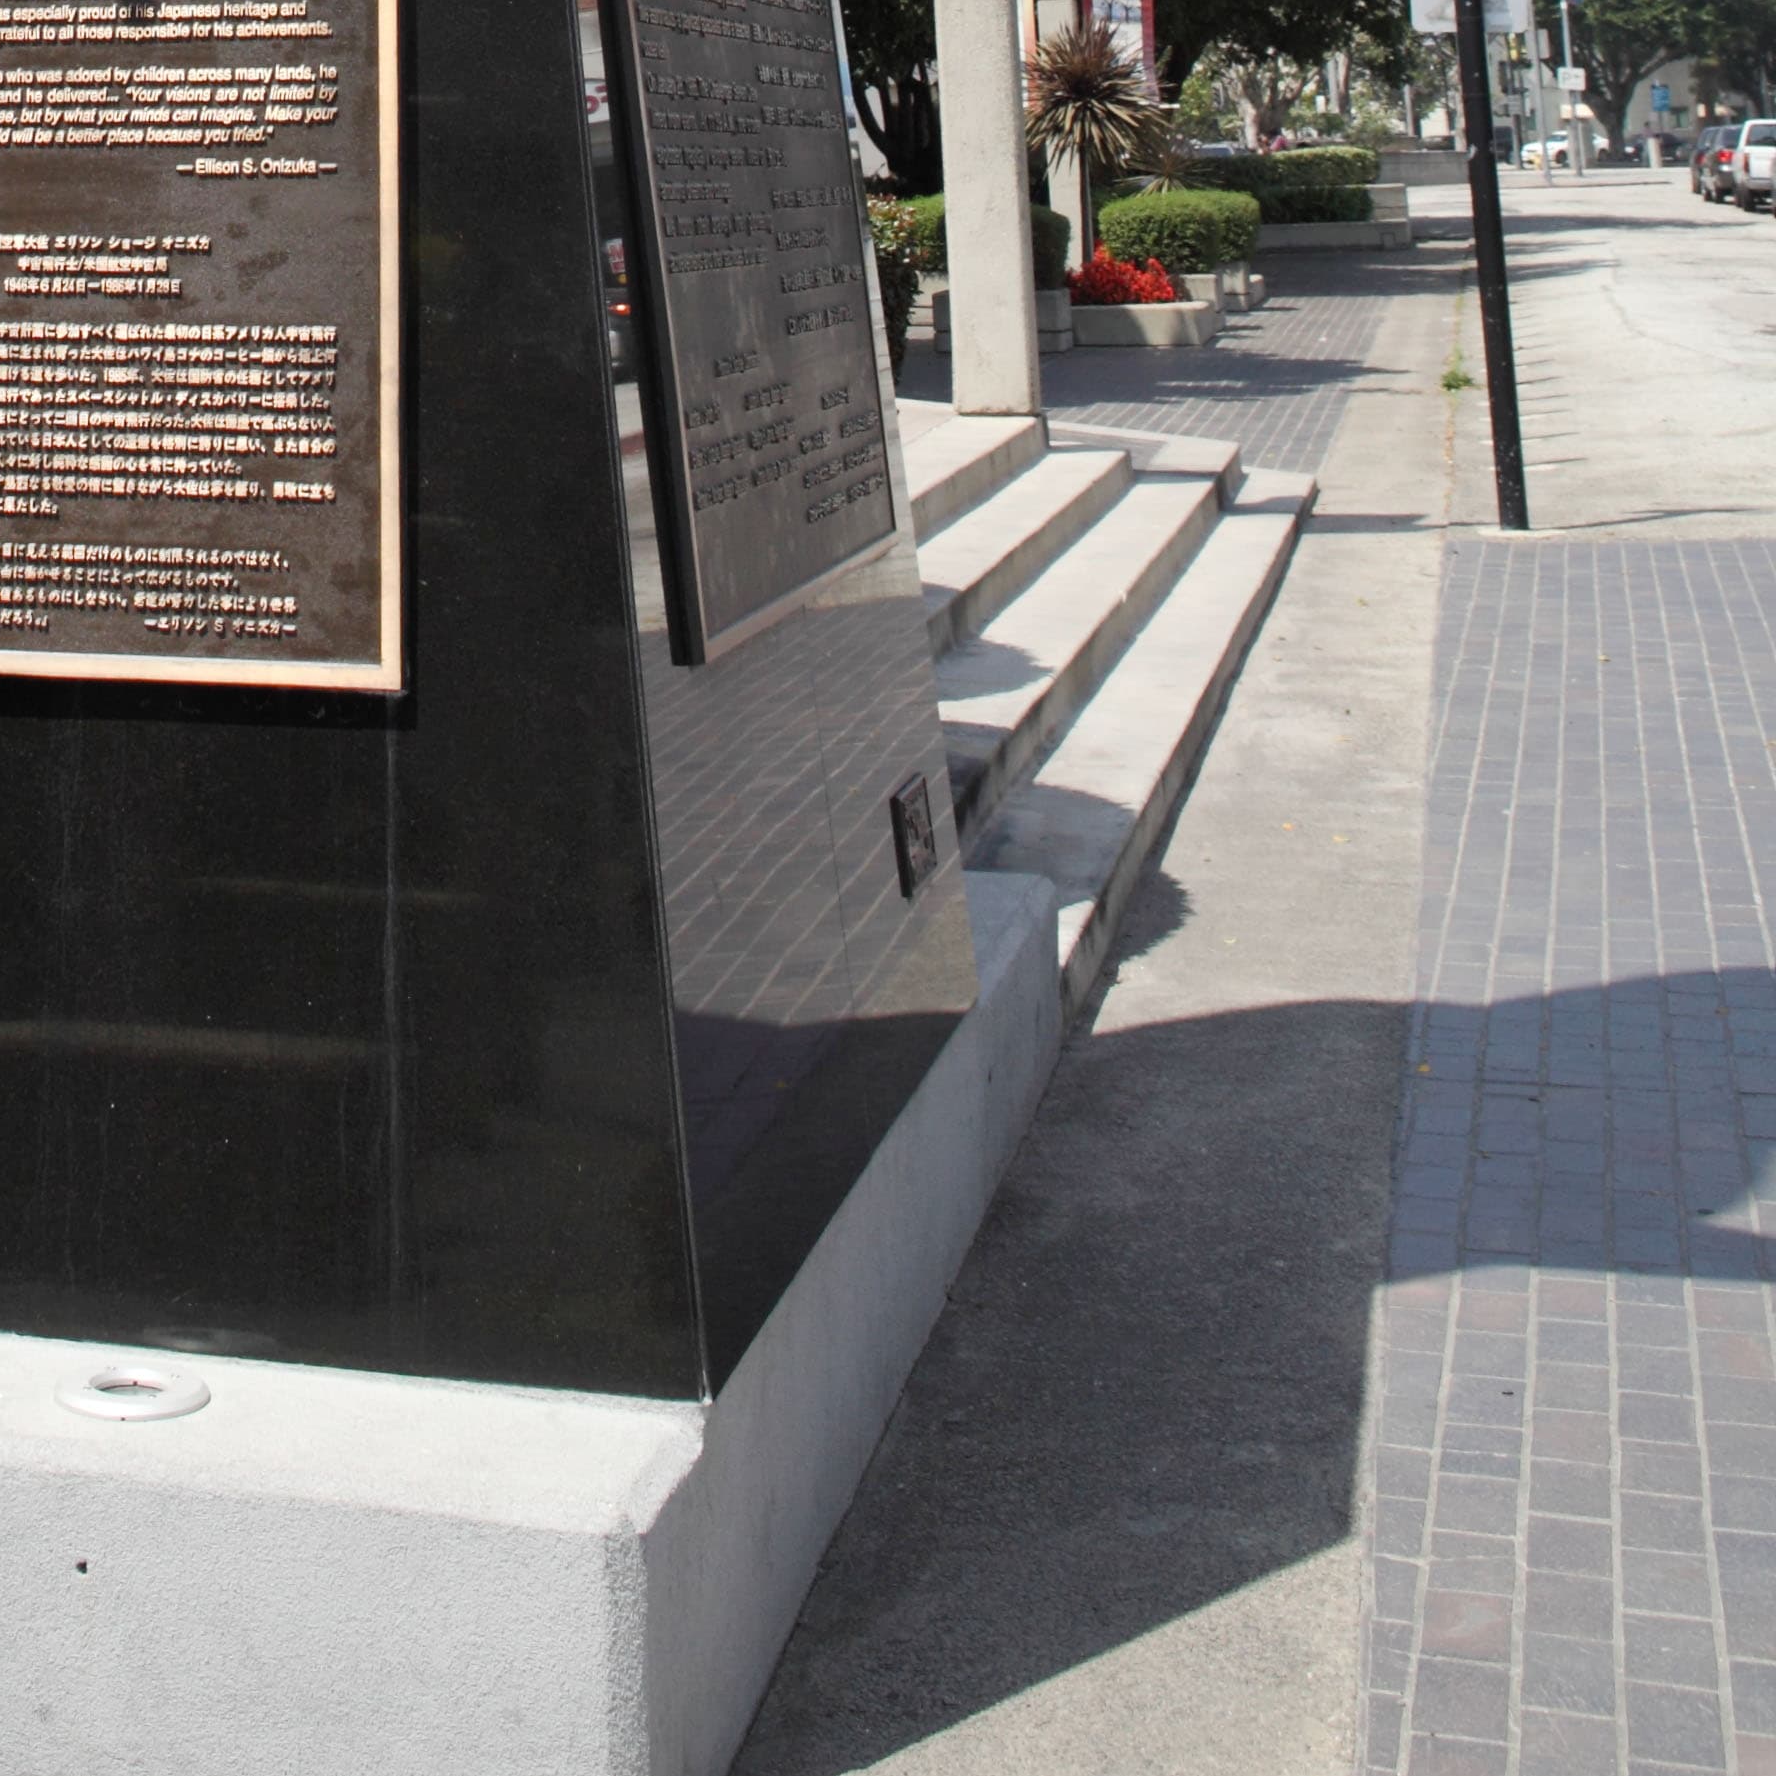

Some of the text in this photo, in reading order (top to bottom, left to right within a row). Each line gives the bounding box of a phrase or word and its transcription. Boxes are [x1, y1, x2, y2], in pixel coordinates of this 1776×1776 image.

[12, 6, 76, 23] especially
[78, 4, 116, 22] proud
[157, 2, 220, 20] Japanese
[223, 1, 278, 19] heritage
[77, 24, 113, 39] those
[115, 23, 190, 40] responsible
[236, 20, 333, 36] achievements.
[65, 67, 111, 83] adored
[133, 66, 185, 83] children
[187, 68, 232, 82] across
[234, 67, 273, 83] many
[275, 64, 316, 82] lands,
[165, 86, 212, 102] visions
[269, 84, 314, 100] limited
[64, 107, 96, 122] what
[97, 108, 129, 125] your
[130, 106, 170, 123] minds
[200, 105, 257, 124] imagine.
[264, 105, 302, 121] Make
[304, 107, 338, 123] your
[11, 127, 33, 143] will
[66, 126, 104, 142] better
[106, 127, 144, 145] place
[145, 126, 202, 143] because
[195, 158, 317, 174] Ellison S. Onizuka
[53, 234, 103, 250] エリソン
[108, 235, 157, 251] ショージ
[161, 235, 212, 252] オニズカ
